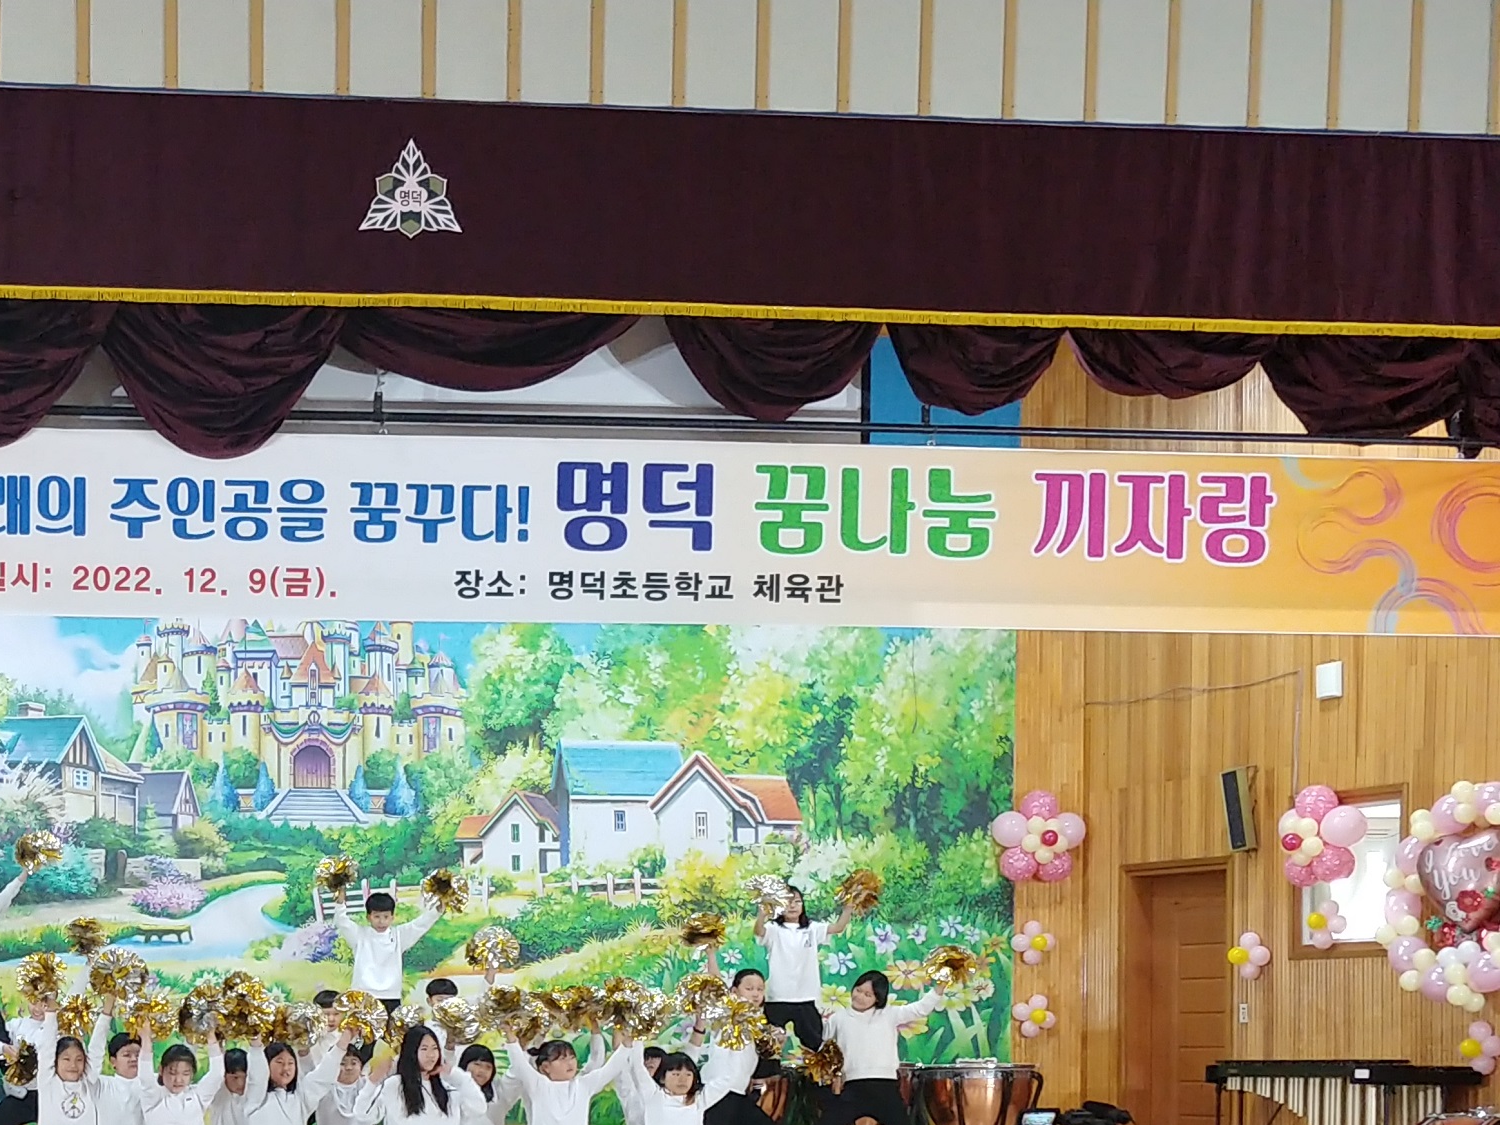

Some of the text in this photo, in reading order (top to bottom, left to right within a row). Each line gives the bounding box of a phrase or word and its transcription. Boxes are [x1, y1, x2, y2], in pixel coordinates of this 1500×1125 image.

[399, 189, 423, 207] 명덕
[110, 477, 327, 543] 주인공을
[350, 482, 530, 543] 꿈꾸다!
[557, 461, 714, 551] 명덕
[755, 465, 995, 558] 꿈나눔
[1034, 473, 1274, 563] 끼자랑
[73, 565, 163, 595] 2022.
[184, 568, 228, 597] 12.
[249, 568, 337, 598] 9(금).
[454, 569, 844, 604] 장소: 명덕초등학교 체육관
[1432, 867, 1481, 901] You
